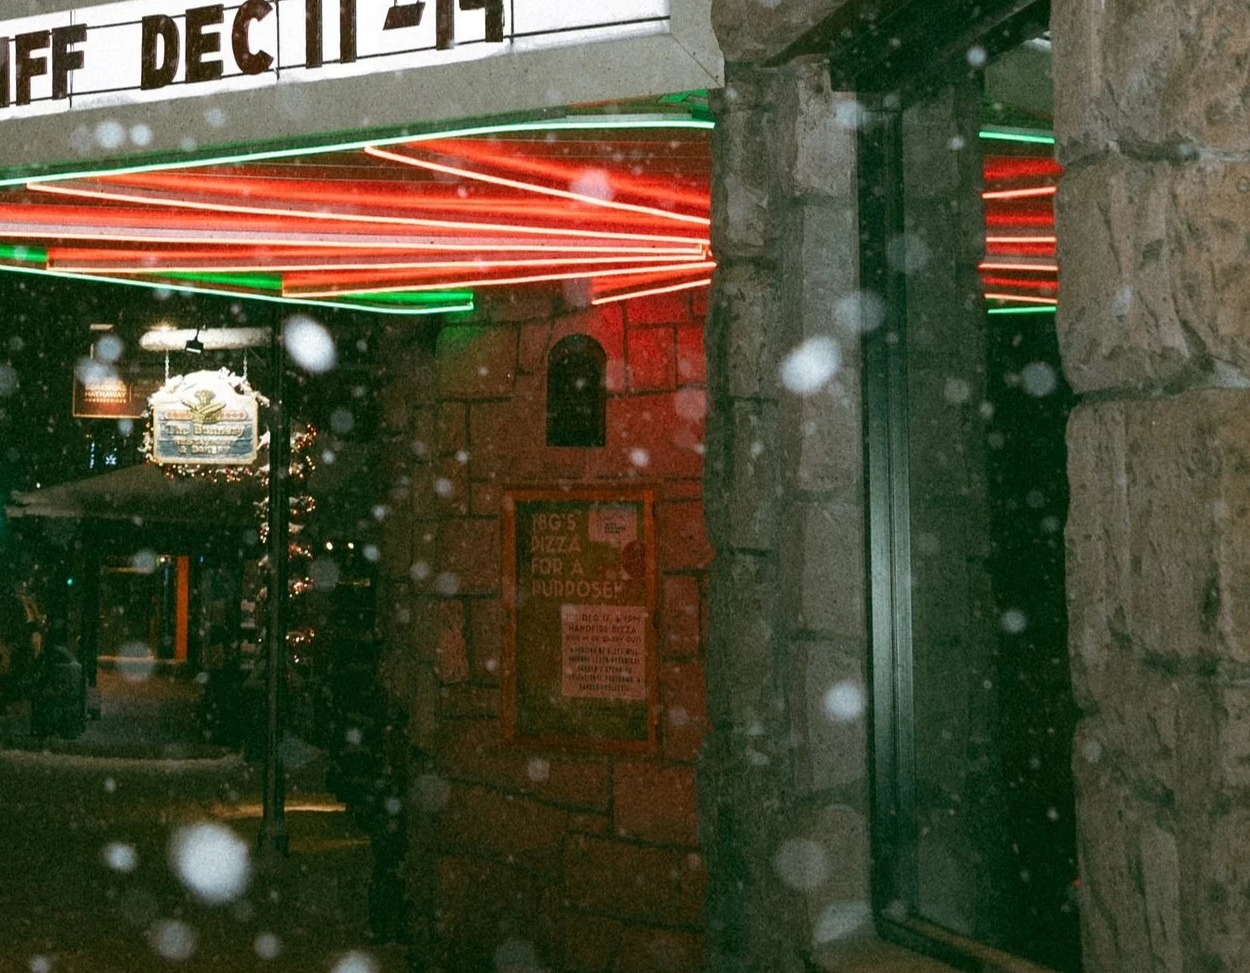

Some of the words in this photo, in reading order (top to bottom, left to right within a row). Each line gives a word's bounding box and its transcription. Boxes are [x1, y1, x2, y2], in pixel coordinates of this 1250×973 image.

[530, 536, 581, 553] PIZZA
[531, 558, 563, 576] FOR
[570, 559, 585, 576] A
